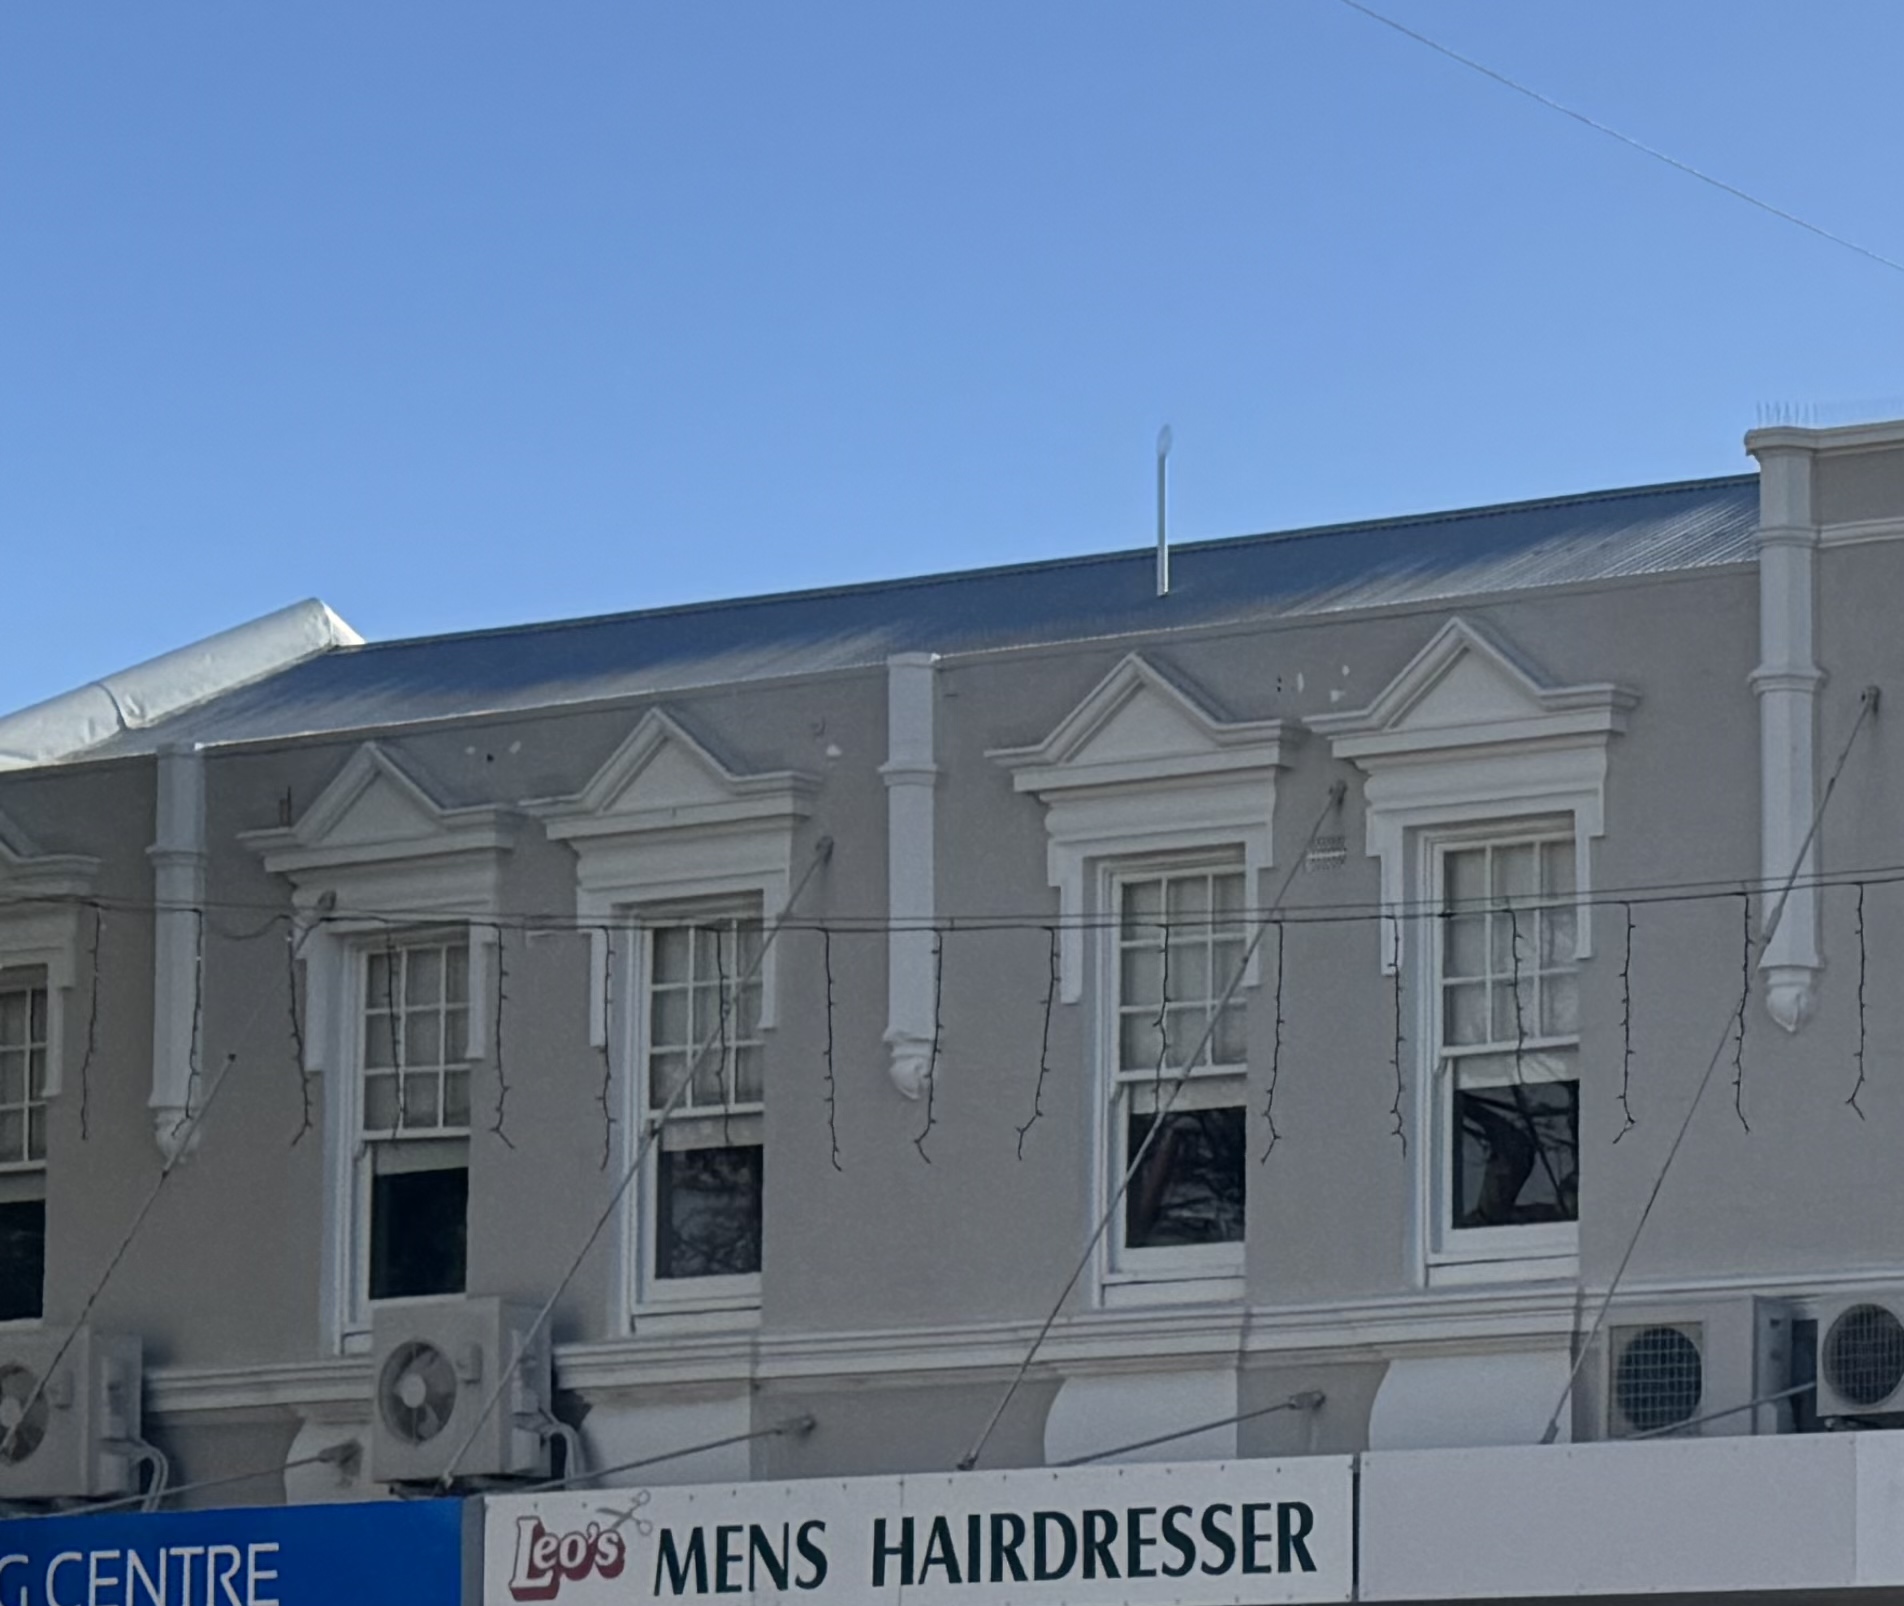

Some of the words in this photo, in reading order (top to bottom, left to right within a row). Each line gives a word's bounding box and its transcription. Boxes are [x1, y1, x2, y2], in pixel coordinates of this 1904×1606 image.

[509, 1515, 626, 1602] Leo's
[654, 1520, 827, 1596] MENS
[872, 1501, 1317, 1587] HAIRDRESSER
